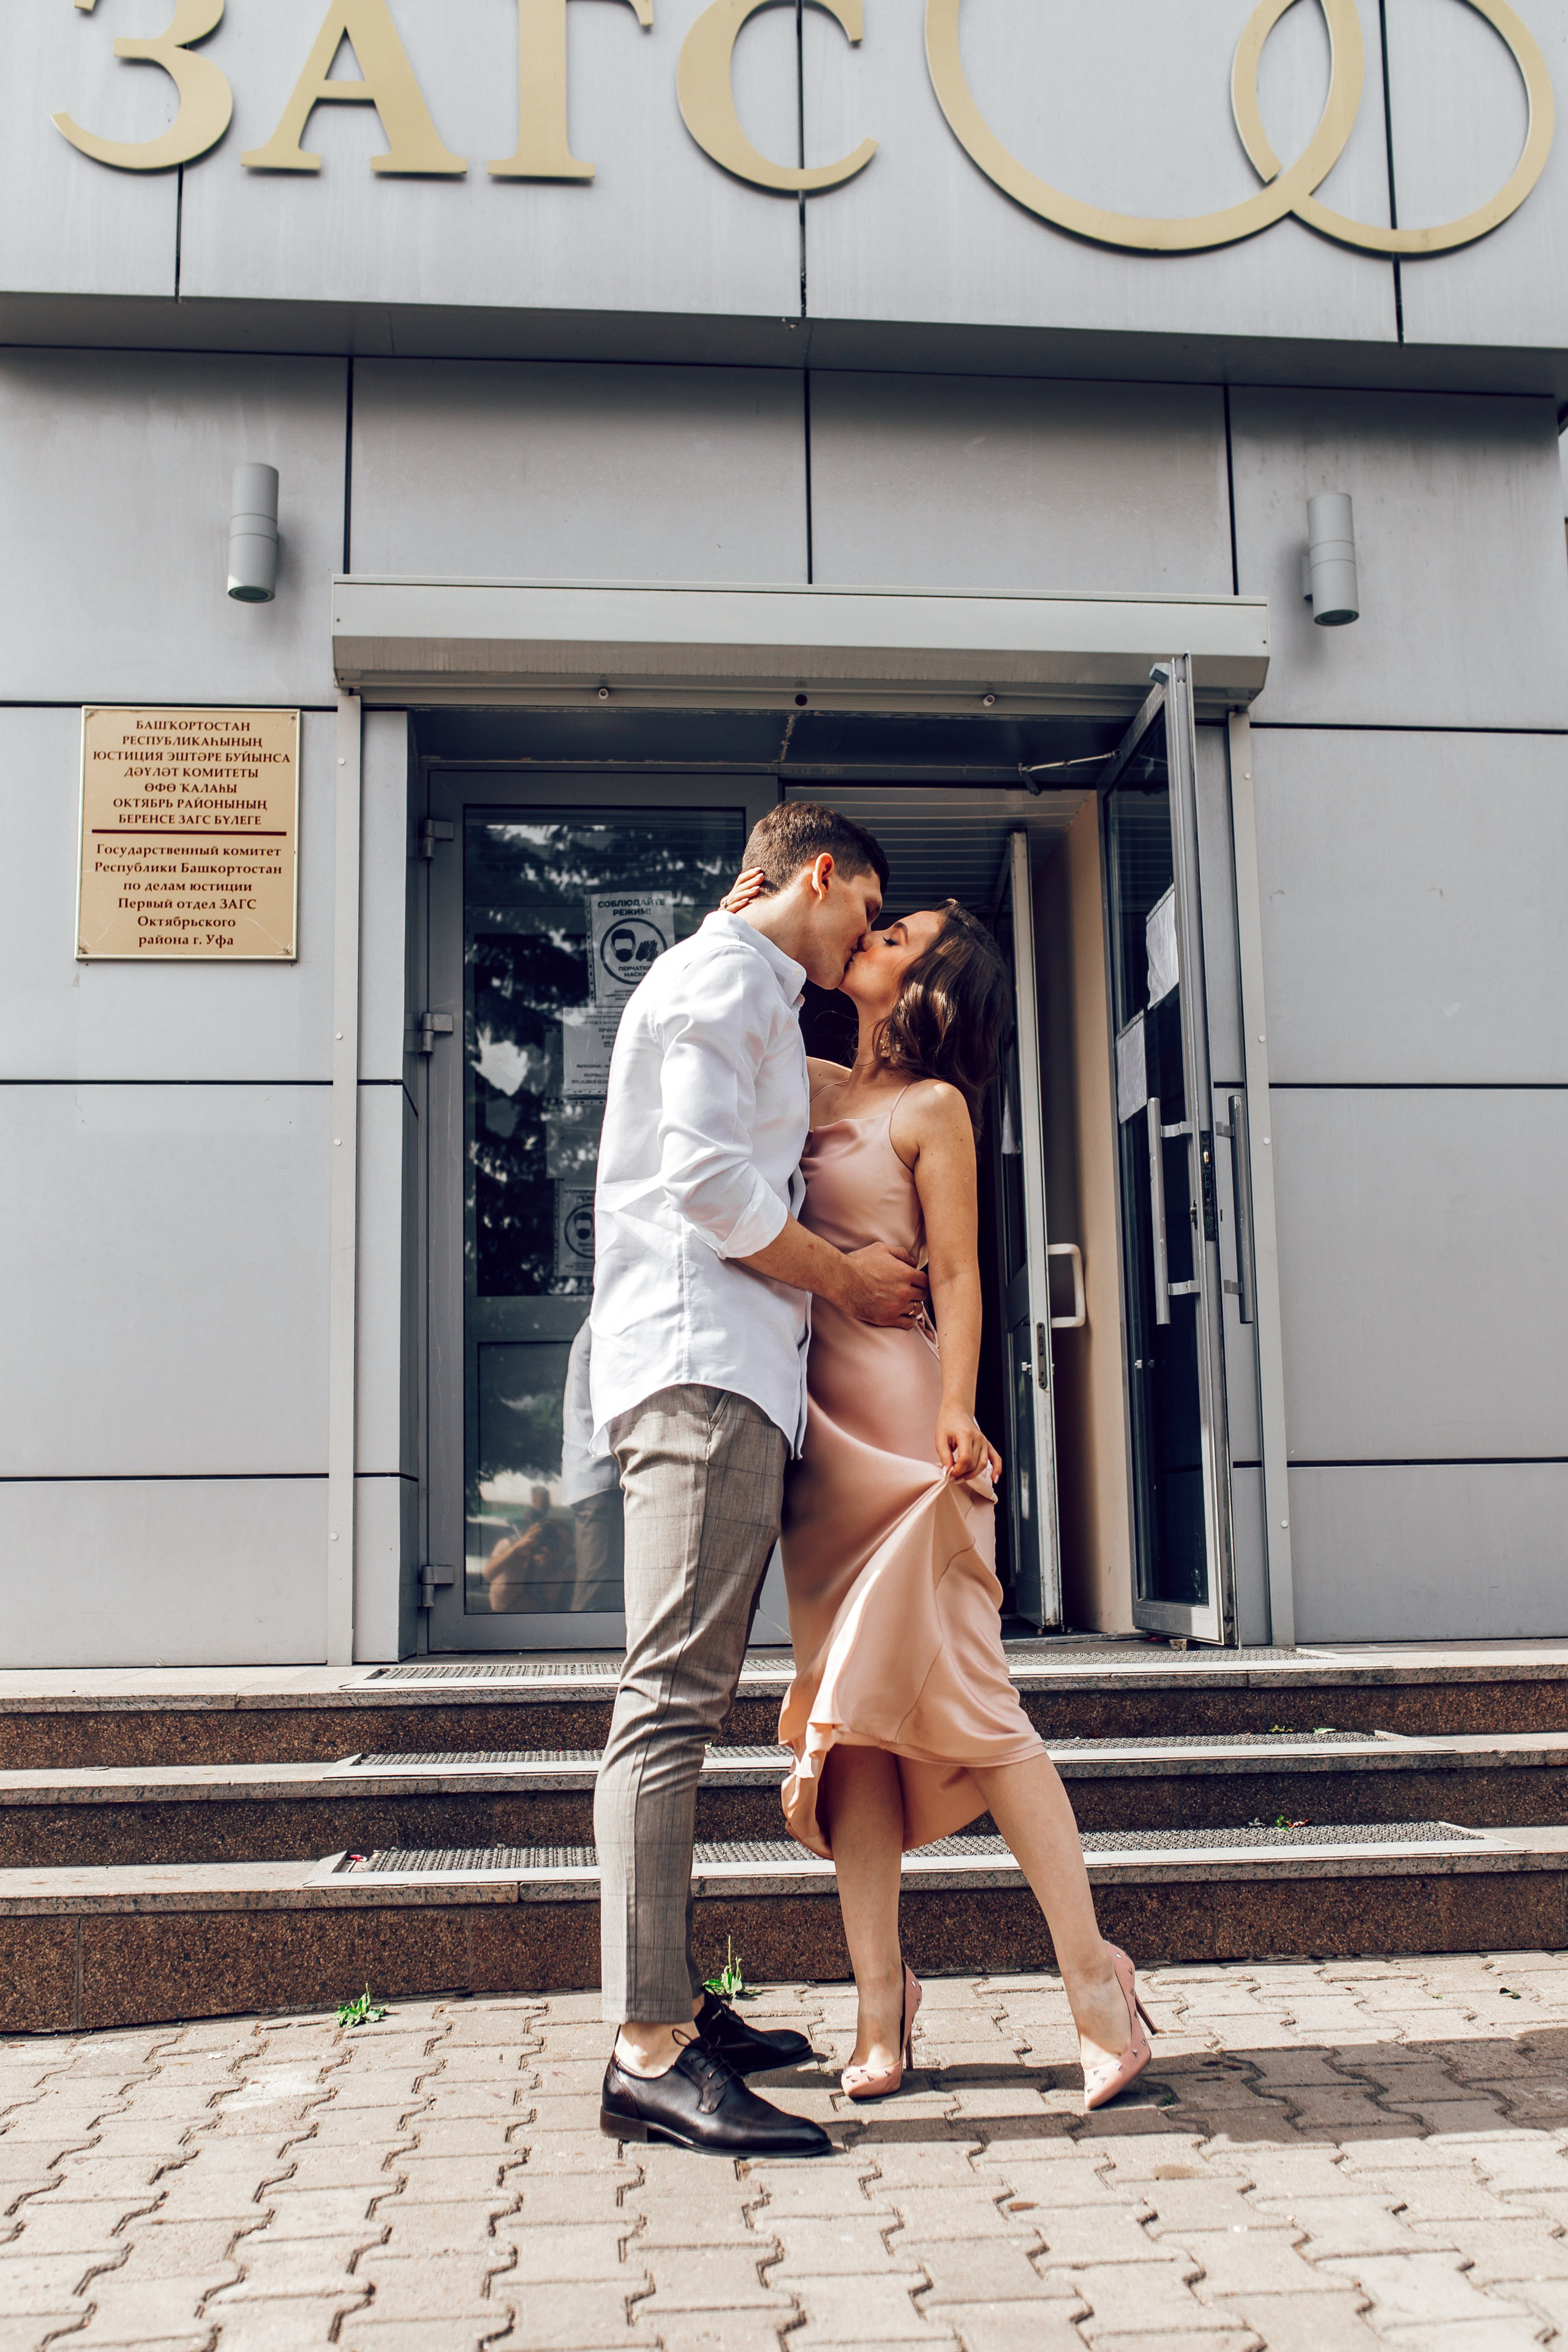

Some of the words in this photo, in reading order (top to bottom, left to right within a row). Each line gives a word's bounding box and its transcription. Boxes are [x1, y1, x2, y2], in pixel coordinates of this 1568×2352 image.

[51, 0, 880, 190] ЗАГС
[93, 751, 163, 762] ЮСТИЦИЯ
[167, 752, 222, 762] ЭШТӘРЕ
[225, 751, 290, 763] БУЙЫНСА
[124, 767, 179, 778] ДӘҮЛӘТ
[183, 767, 258, 778] КОМИТЕТЫ
[145, 783, 176, 793] ӨФӨ
[113, 798, 173, 809] ОКТЯБРЬ
[177, 797, 268, 812] РАЙОНЫНЫҢ
[119, 814, 175, 824] БЕРЕНСЕ
[178, 815, 211, 825] ЗАГС
[214, 815, 262, 825] БҮЛЕГЕ
[97, 843, 219, 858] Государственный
[223, 847, 282, 856] комитет
[95, 861, 176, 876] Республики
[181, 862, 282, 876] Башкортостан
[144, 883, 186, 892] делам
[189, 883, 252, 893] юстиции
[118, 897, 173, 911] Первый
[176, 901, 216, 911] отдел
[219, 898, 257, 910] ЗАГС
[598, 898, 665, 908] СОБЛЮДАЙТЕ
[137, 916, 236, 930] Октябрьского
[138, 934, 189, 948] района
[206, 934, 233, 948] Уфа
